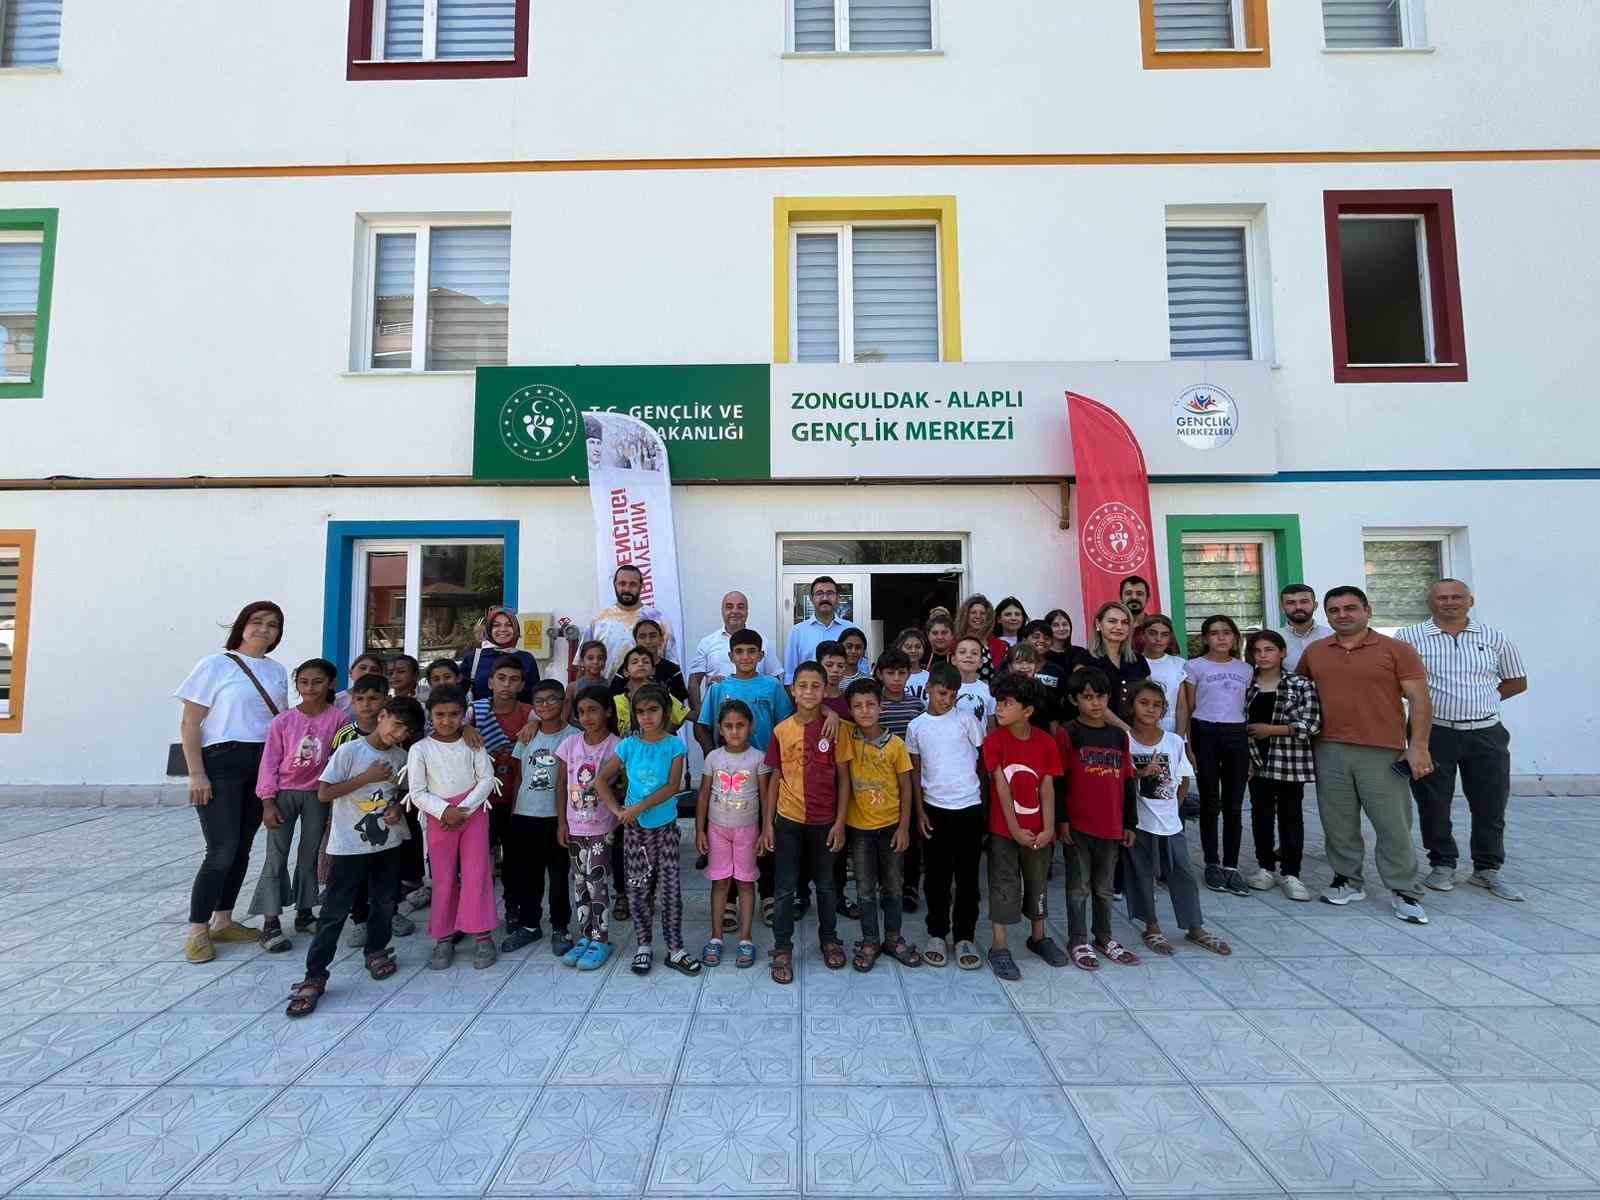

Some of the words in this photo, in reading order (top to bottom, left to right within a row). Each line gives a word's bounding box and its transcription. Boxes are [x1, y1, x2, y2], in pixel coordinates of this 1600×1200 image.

[791, 391, 930, 410] ZONGULDAK
[947, 390, 1024, 409] ALAPLI
[629, 401, 713, 423] GENÇLİK
[719, 404, 744, 419] VE
[656, 422, 744, 441] AKANLIĞI
[791, 417, 899, 447] GENÇLİK
[905, 416, 1014, 441] MERKEZİ
